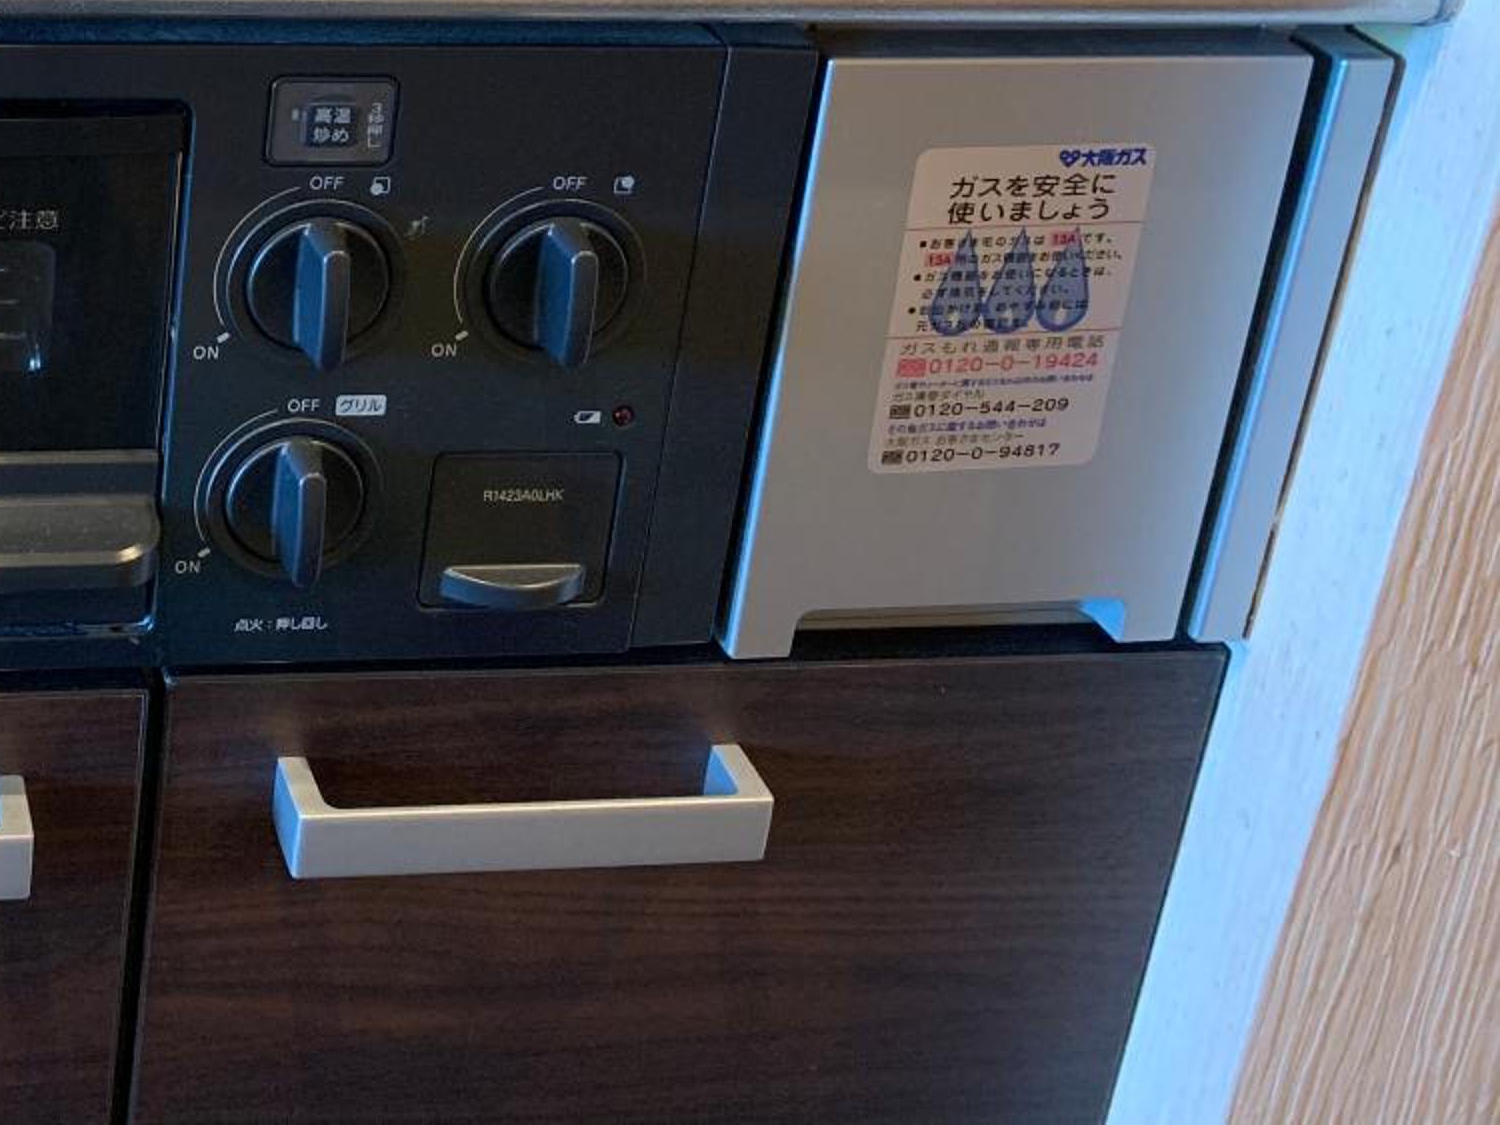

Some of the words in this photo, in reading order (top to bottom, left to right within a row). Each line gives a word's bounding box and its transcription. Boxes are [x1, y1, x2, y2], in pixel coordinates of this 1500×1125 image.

[314, 107, 351, 124] 高温
[313, 126, 350, 144] 炒め
[1081, 148, 1147, 167] 大阪ガス
[309, 175, 344, 191] OFF
[552, 175, 588, 191] OFF
[949, 173, 1117, 200] ガスを安全に
[947, 197, 1111, 225] 使いましょう
[193, 345, 220, 361] ON
[431, 342, 457, 358] ON
[900, 335, 1106, 356] ガスもれ通報専用電話
[929, 352, 1098, 374] 0120-0-19424
[287, 398, 321, 413] OFF
[338, 397, 384, 414] グリル
[914, 398, 1070, 419] 0120-544-209
[905, 443, 1061, 464] 0120-0-94817
[175, 560, 201, 575] ON
